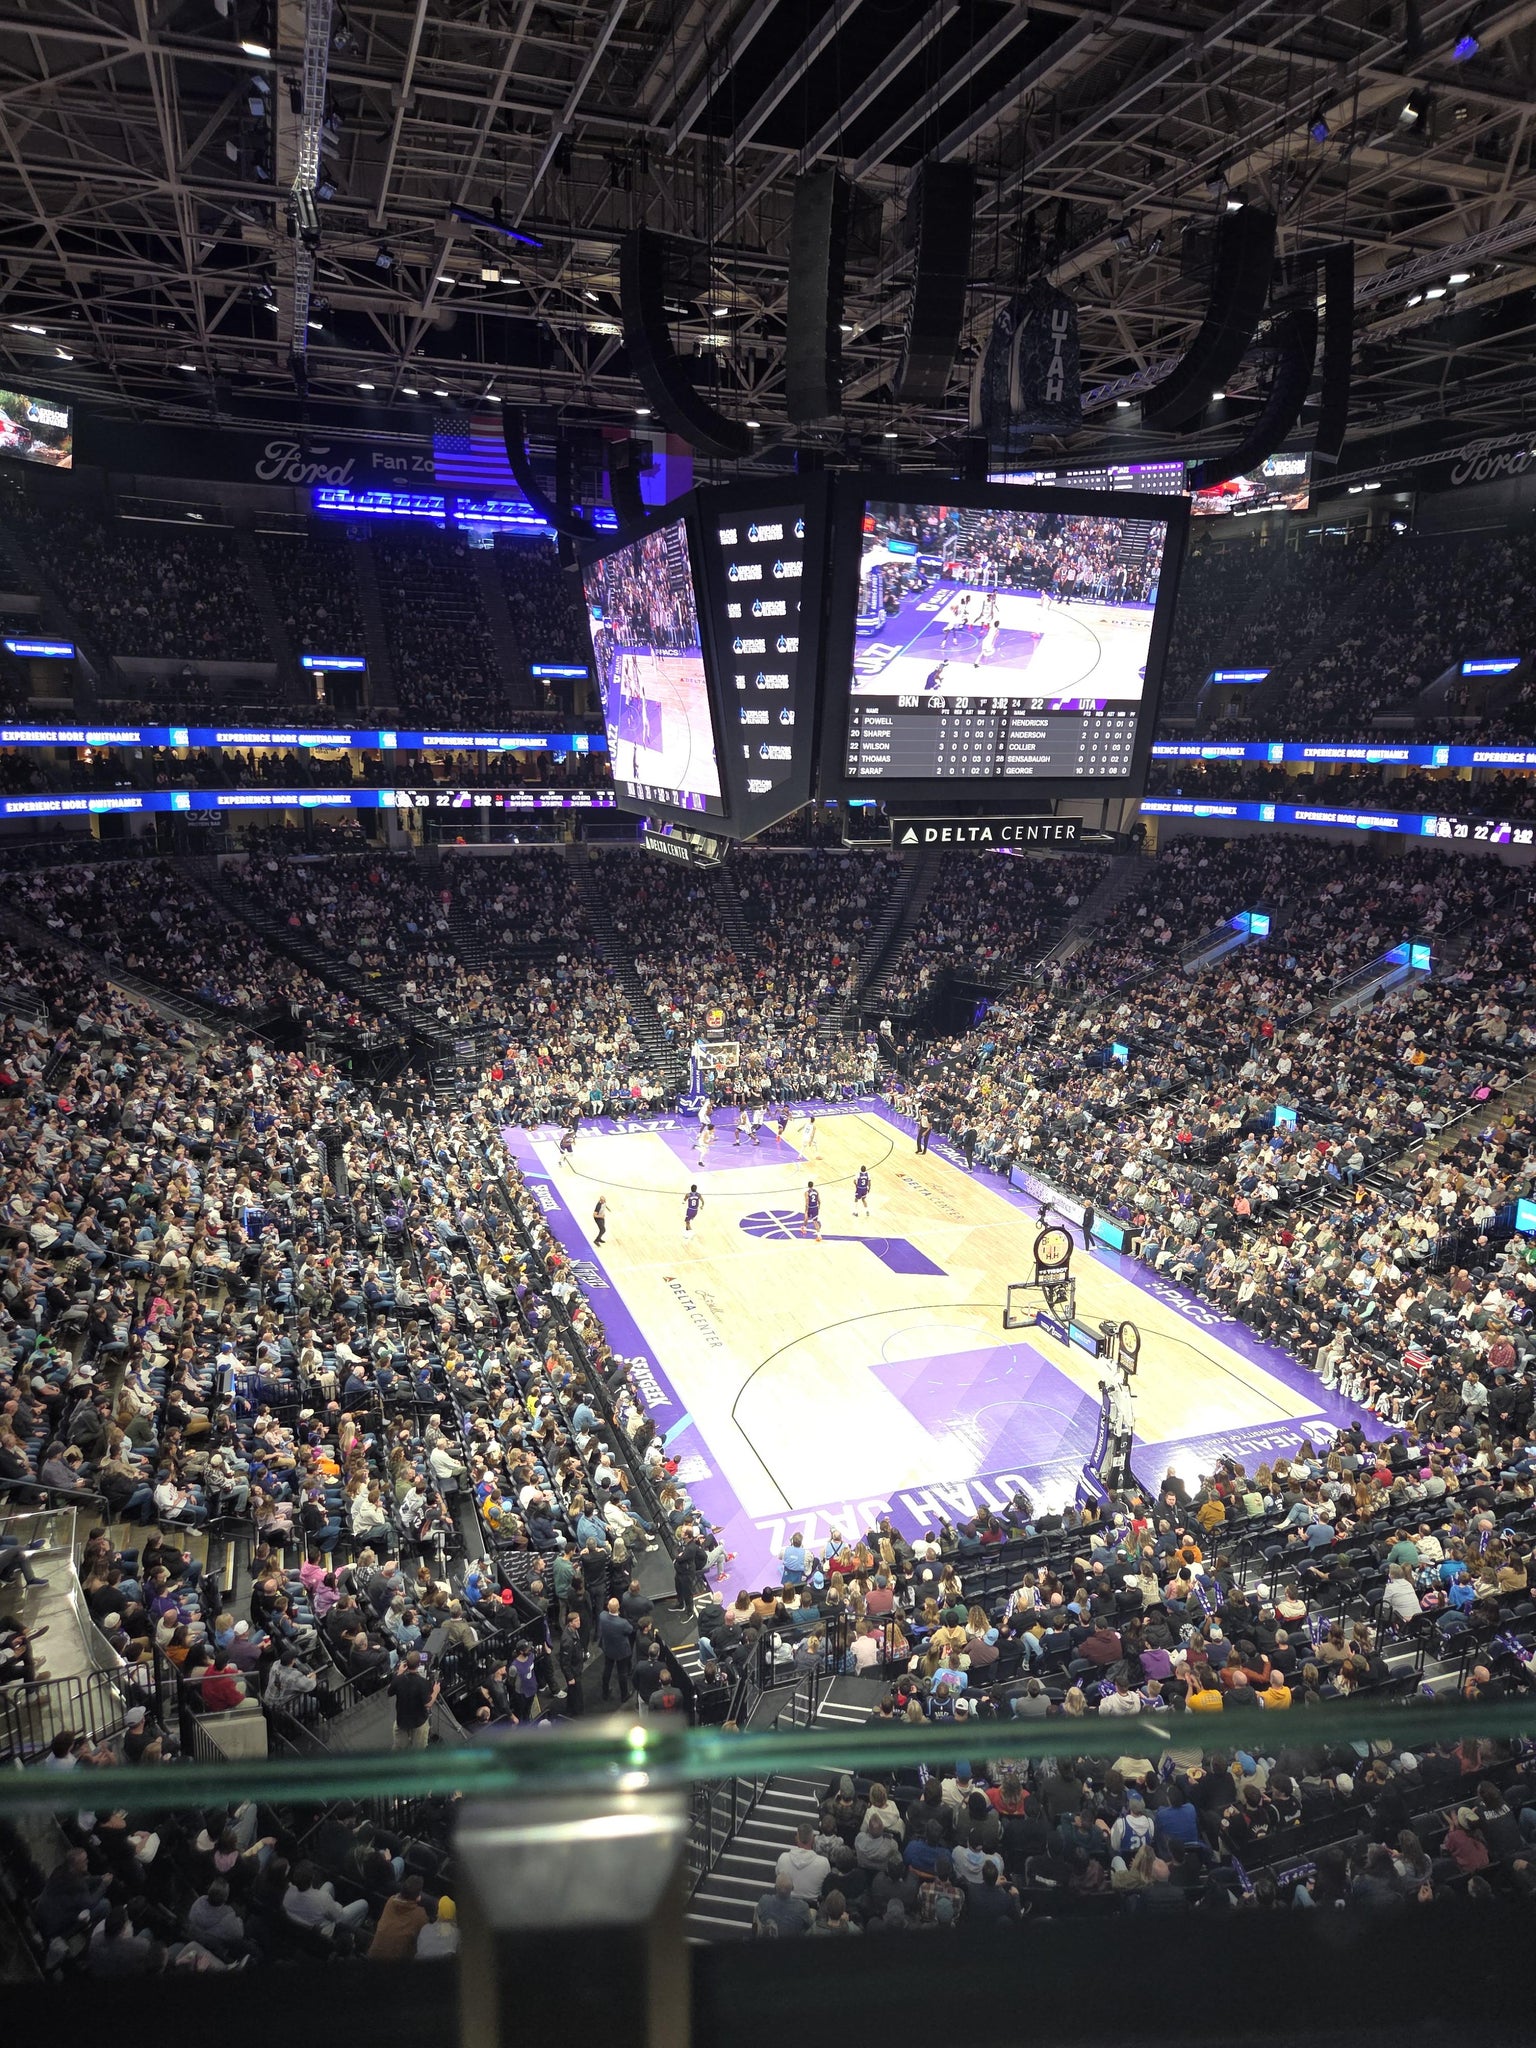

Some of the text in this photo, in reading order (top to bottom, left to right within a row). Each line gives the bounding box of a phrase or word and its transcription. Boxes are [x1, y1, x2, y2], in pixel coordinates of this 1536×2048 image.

[1045, 309, 1069, 402] UTAH
[255, 441, 355, 486] Ford
[371, 452, 407, 470] Fan
[898, 696, 919, 707] BKN
[956, 697, 968, 708] 20
[992, 698, 1008, 709] 3:02
[1031, 699, 1043, 709] 22
[1078, 700, 1096, 710] UTA
[2, 731, 57, 741] EXPERIENCE
[58, 731, 84, 741] MORE
[216, 733, 271, 742] EXPERIENCE
[272, 734, 297, 743] MORE
[423, 736, 474, 745] EXPERIENCE
[475, 737, 498, 746] MORE
[1179, 747, 1200, 755] MORE
[1304, 748, 1346, 757] EXPERIENCE
[1347, 749, 1366, 758] MORE
[1473, 752, 1525, 763] EXPERIENCE
[862, 755, 891, 763] THOMAS
[6, 801, 60, 812] EXPERIENCE
[62, 800, 87, 810] MORE
[217, 795, 271, 804] EXPERIENCE
[272, 795, 298, 804] MORE
[415, 795, 430, 806] 20
[436, 795, 450, 806] 22
[185, 809, 222, 821] G2G
[1172, 804, 1193, 813] MORE
[1295, 811, 1336, 822] EXPERIENCE
[1337, 814, 1356, 824] MORE
[925, 825, 1075, 842] DELTA CENTER
[1454, 824, 1468, 838] 20
[1474, 825, 1489, 840] 22
[649, 838, 689, 860] DELTA CENTER
[608, 1120, 682, 1136] JAZZ
[903, 1177, 932, 1196] DELTA
[811, 1195, 816, 1203] 2
[1155, 1290, 1220, 1325] PACS
[669, 1283, 697, 1312] DELTA
[690, 1313, 723, 1348] CENTER
[625, 1356, 673, 1410] SEATGEEK
[1093, 1430, 1105, 1464] AMERICA
[754, 1499, 893, 1557] JAZZ
